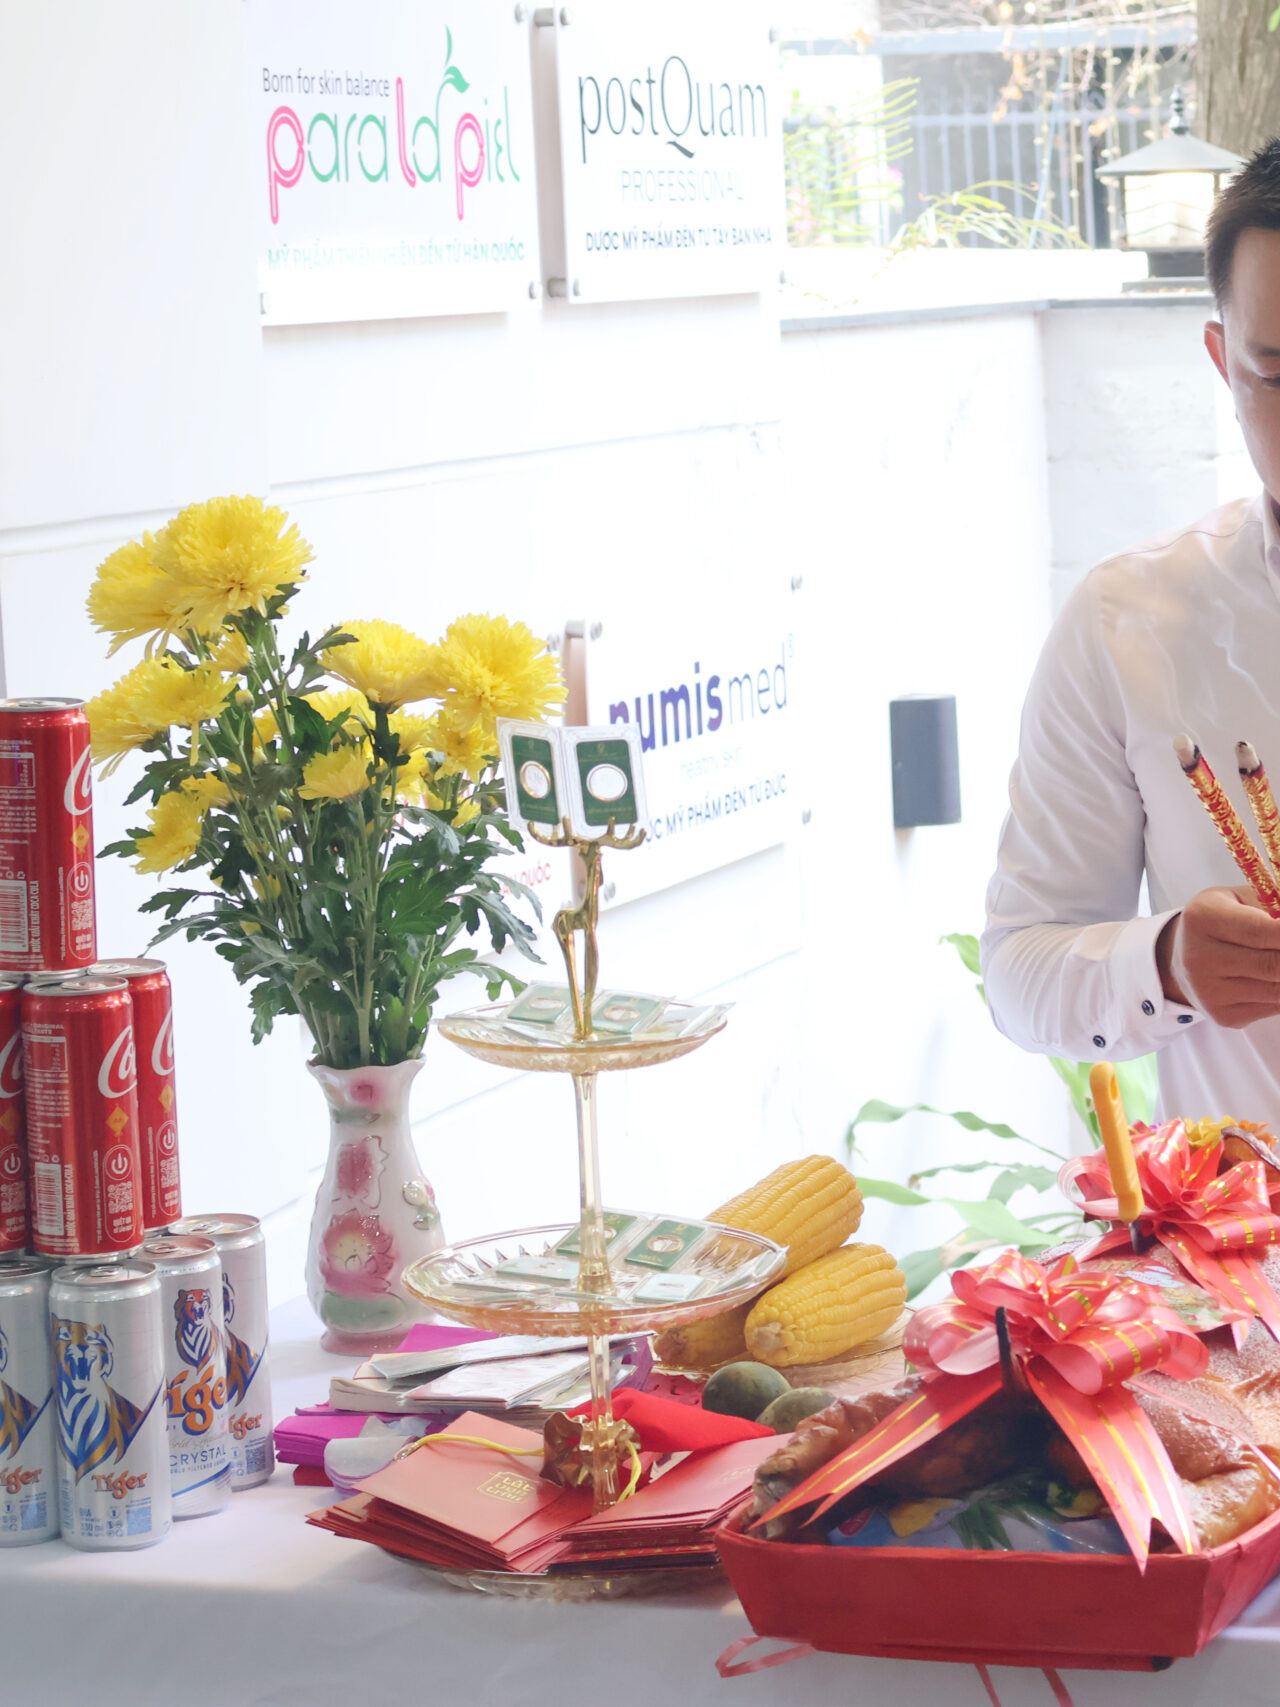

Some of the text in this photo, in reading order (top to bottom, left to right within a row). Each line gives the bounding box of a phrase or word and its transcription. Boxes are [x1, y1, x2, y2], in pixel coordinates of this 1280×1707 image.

[262, 67, 390, 98] Born for skin balance
[578, 56, 768, 164] postQuam
[621, 170, 743, 202] PROFESSIONAL
[228, 1412, 263, 1440] iger
[0, 1465, 43, 1495] iger
[91, 1471, 149, 1500] Tiger
